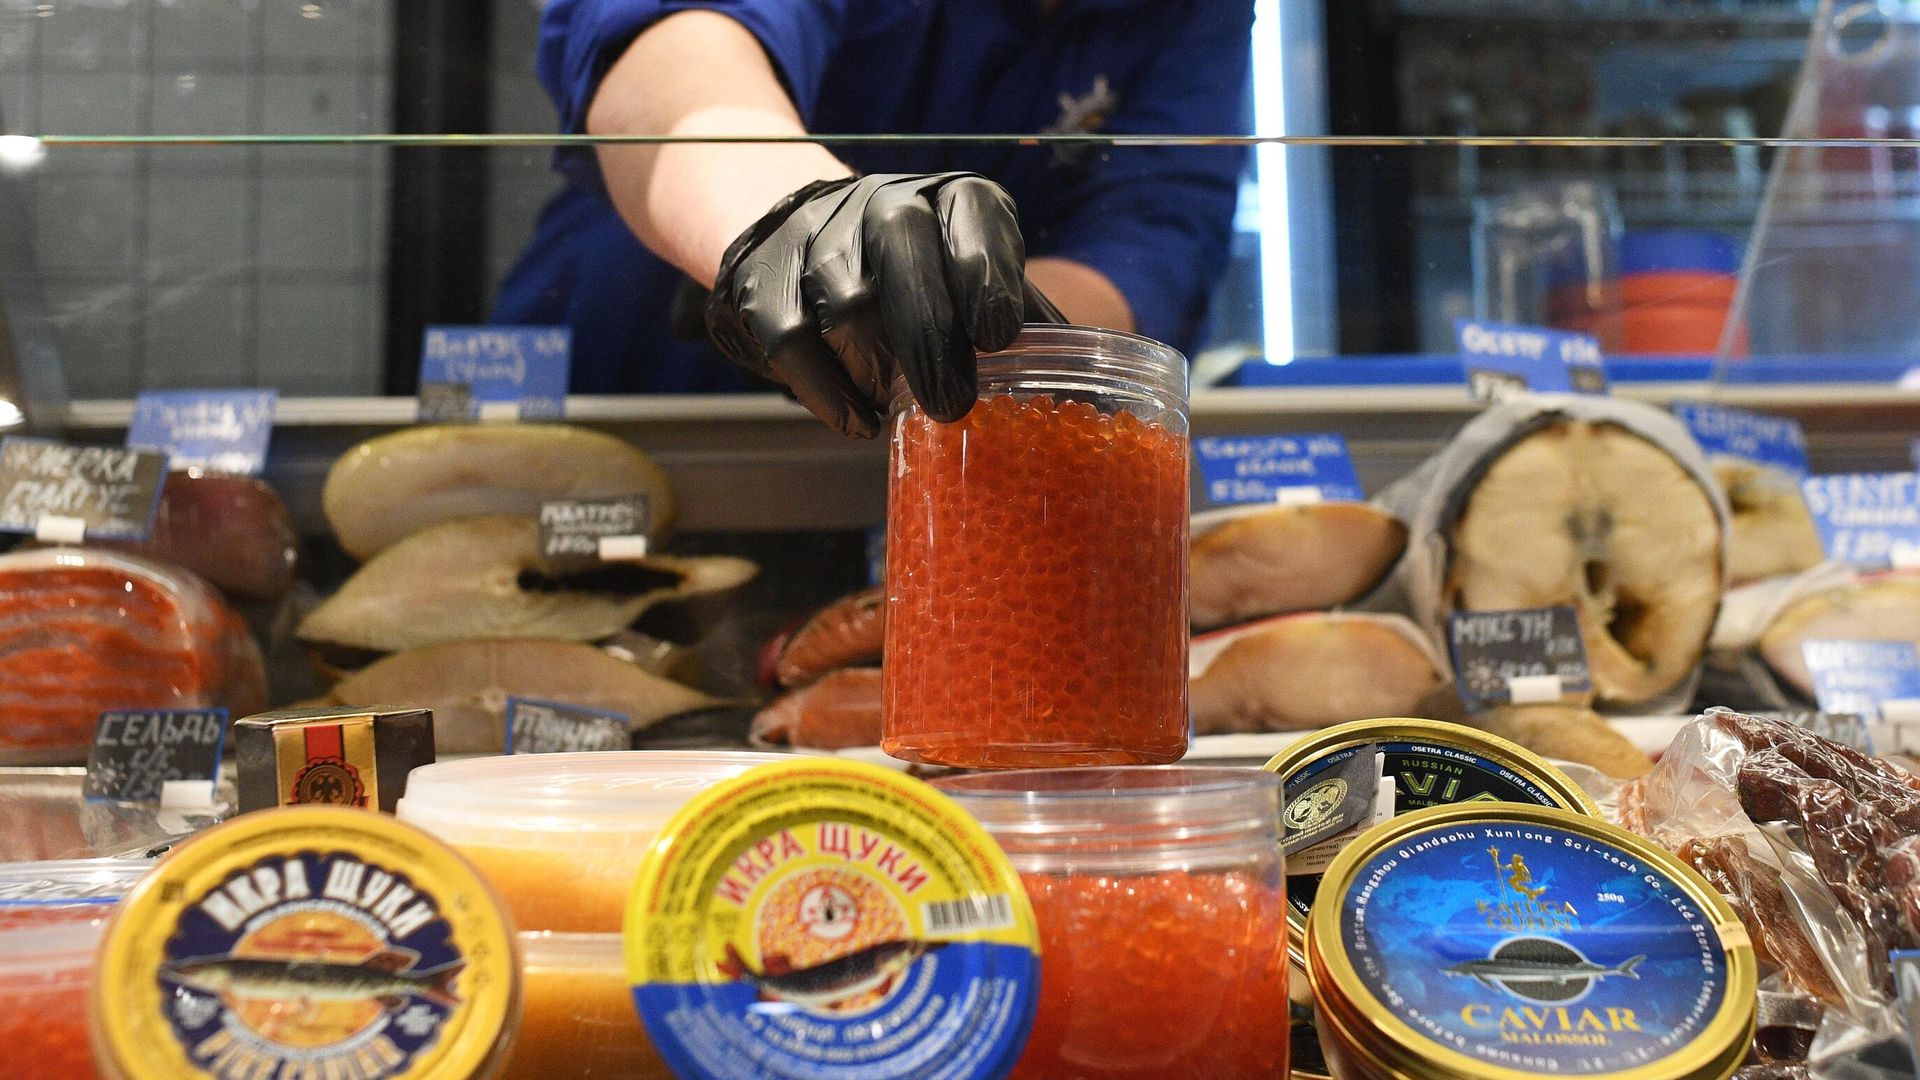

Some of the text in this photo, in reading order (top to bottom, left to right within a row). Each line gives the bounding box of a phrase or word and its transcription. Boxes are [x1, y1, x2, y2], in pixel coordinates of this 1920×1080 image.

[97, 711, 220, 746] СЕЛЬДЬ
[1327, 751, 1354, 764] OSETRA
[1402, 759, 1464, 776] RUSSIAN
[1411, 745, 1478, 764] OSETRA CLASSIC
[1499, 768, 1554, 808] OSETRA CLASSIC
[716, 829, 805, 906] ИКРА
[817, 822, 929, 894] ЩУКИ
[1399, 831, 1475, 859] Qiandaohu
[1485, 828, 1553, 844] Xunlong
[1564, 838, 1638, 874] Sci-tech
[201, 859, 311, 931] ИКРА
[323, 859, 436, 939] ЩУКИ
[1461, 1003, 1643, 1033] CAVIAR
